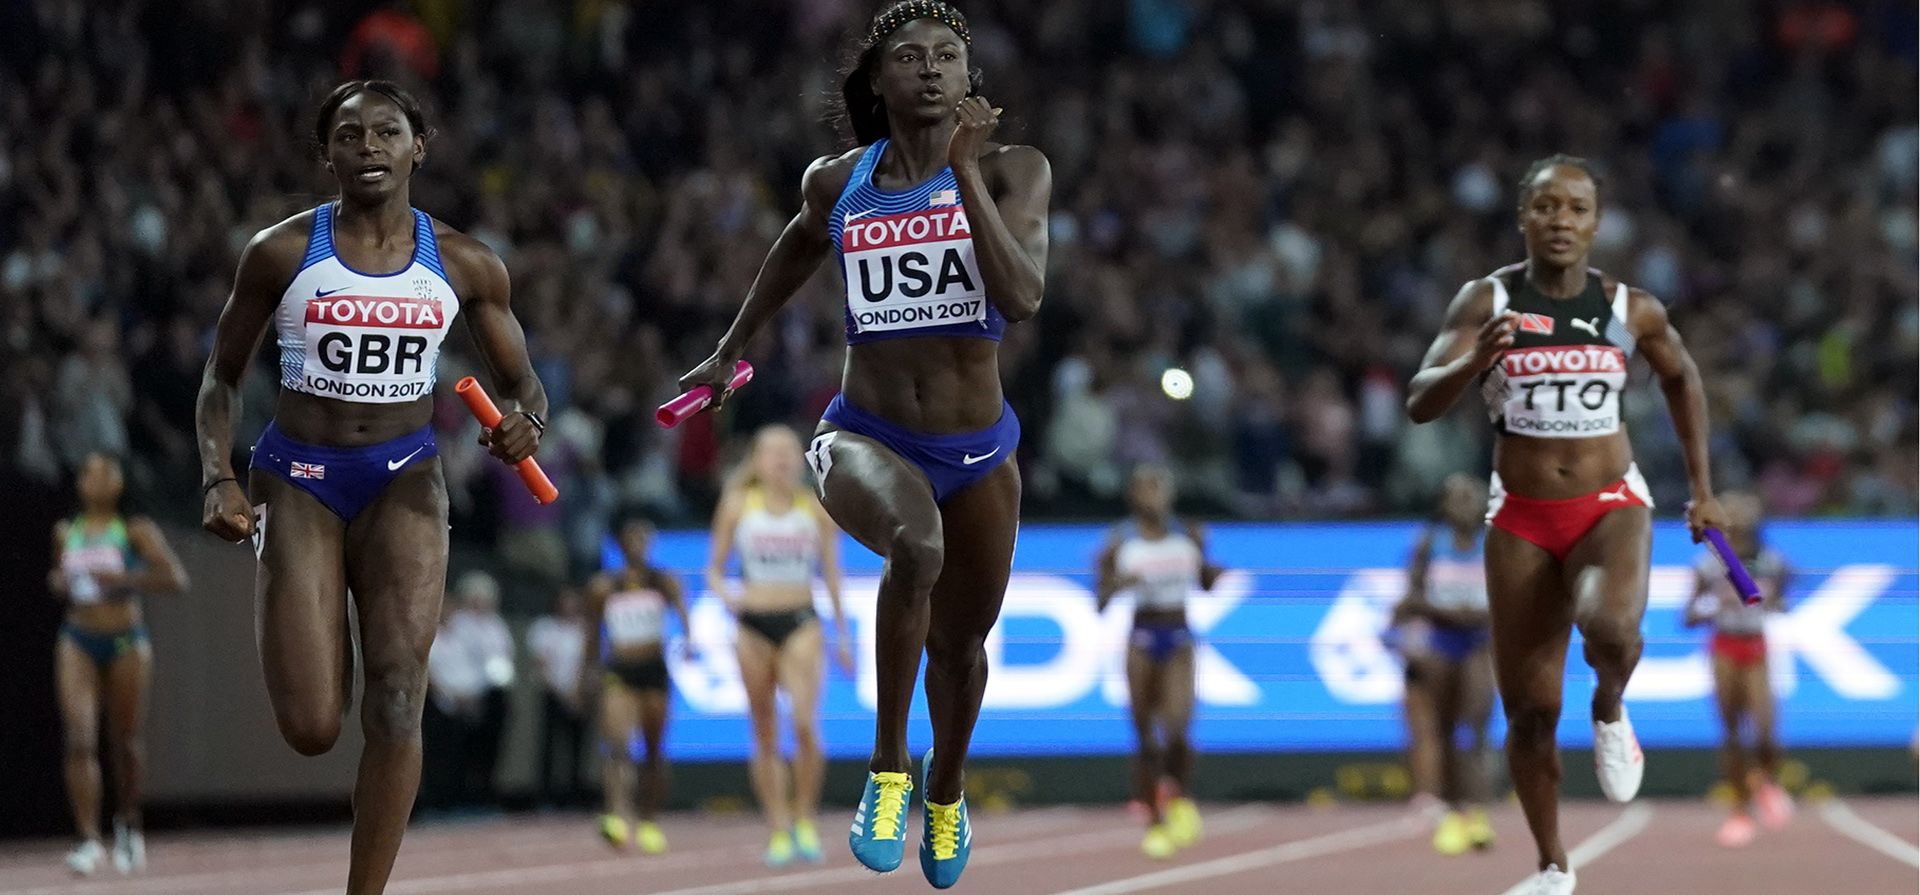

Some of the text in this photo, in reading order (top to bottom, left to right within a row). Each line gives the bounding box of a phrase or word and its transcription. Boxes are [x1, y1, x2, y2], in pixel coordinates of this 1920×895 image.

[846, 211, 970, 247] TOYOTA
[858, 248, 975, 302] USA
[312, 299, 438, 325] TOYOTA
[937, 301, 981, 319] 2017
[318, 332, 427, 374] GBR
[1506, 350, 1620, 373] TOYOTA
[307, 375, 425, 397] LONDON 2017
[1520, 379, 1610, 411] TTO
[1510, 417, 1578, 432] LONDON
